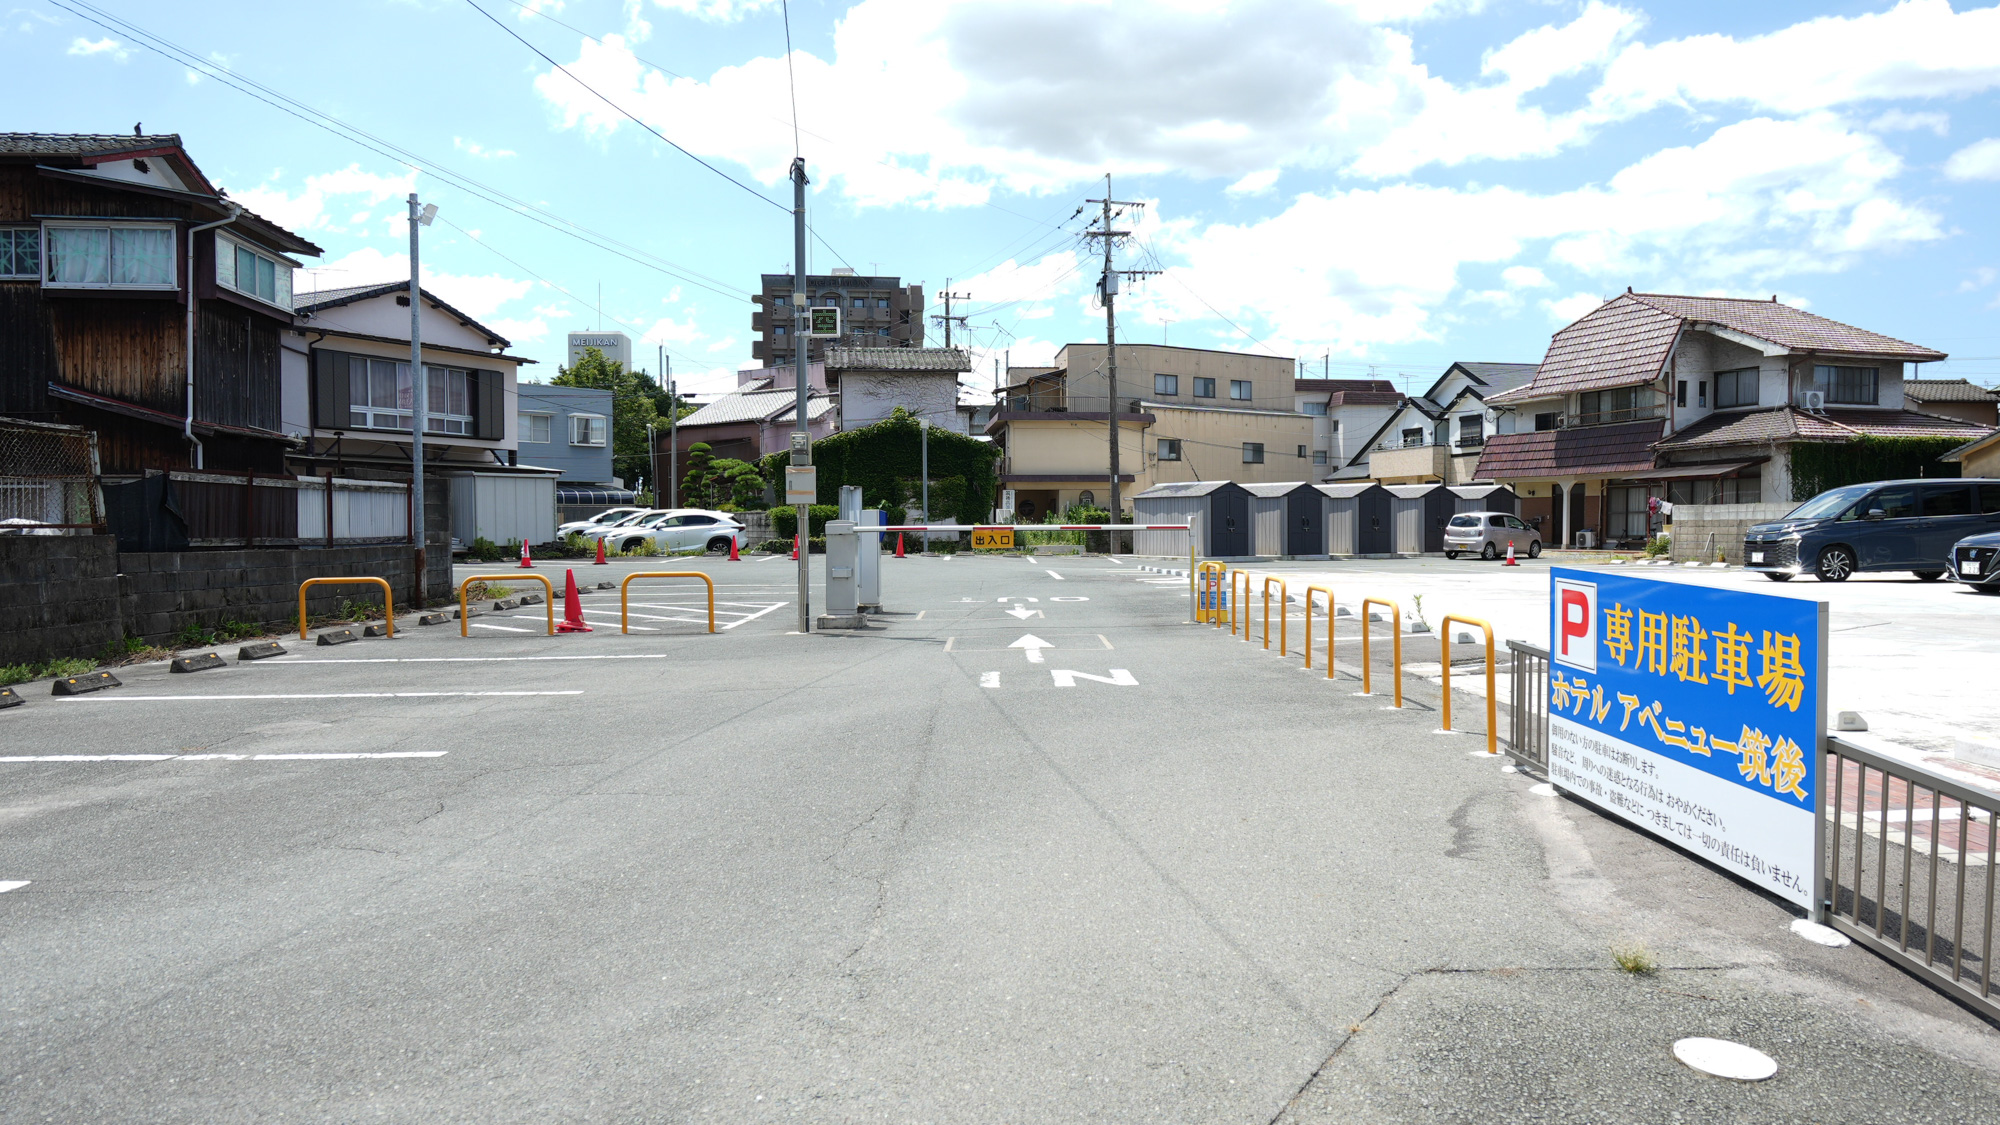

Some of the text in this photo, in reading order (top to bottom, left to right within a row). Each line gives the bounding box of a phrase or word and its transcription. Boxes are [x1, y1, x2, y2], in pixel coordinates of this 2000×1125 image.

[812, 309, 836, 333] 空
[572, 338, 618, 346] MEIJIKAN
[975, 535, 1010, 545] 出入口
[1561, 588, 1590, 656] P
[1603, 602, 1806, 712] 専用駐車場
[980, 669, 1139, 688] IN
